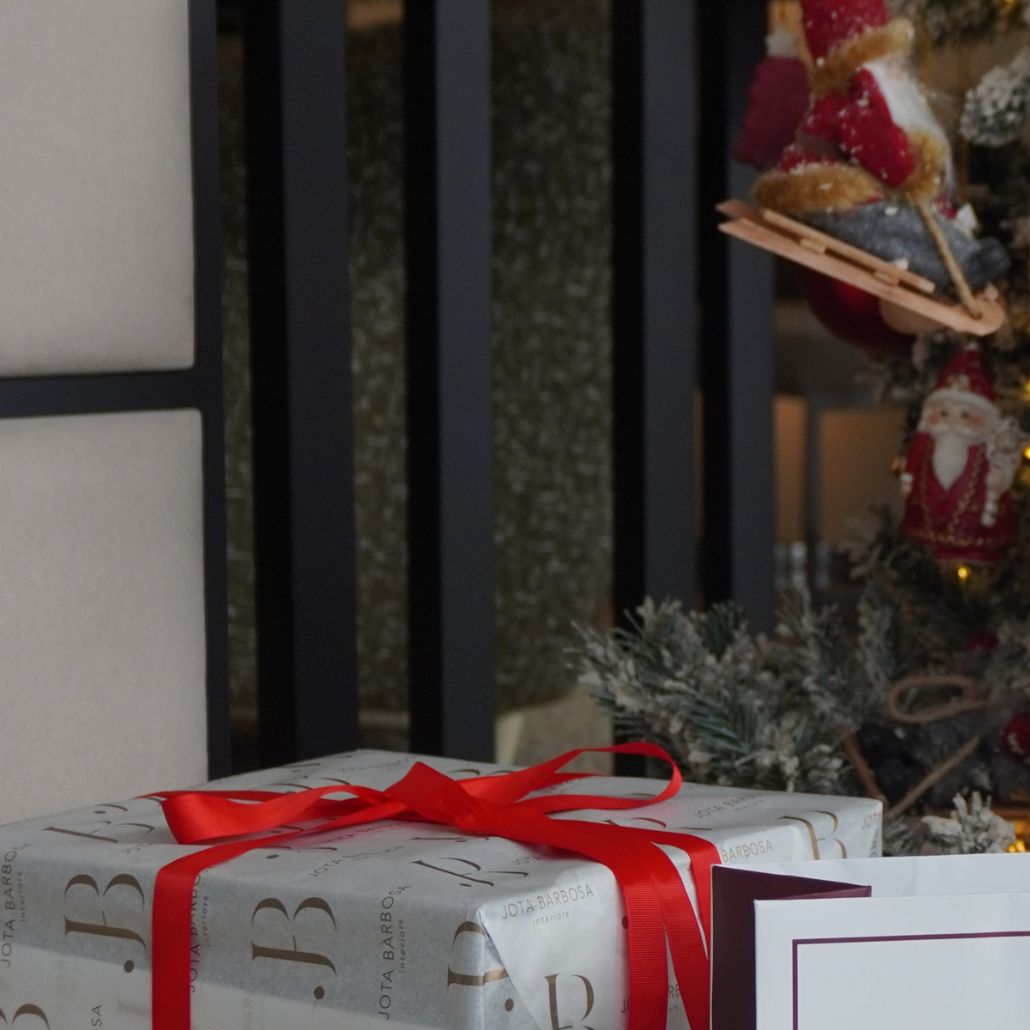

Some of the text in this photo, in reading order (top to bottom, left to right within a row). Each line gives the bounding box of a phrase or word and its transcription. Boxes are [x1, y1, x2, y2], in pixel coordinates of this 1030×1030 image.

[720, 839, 774, 863] BARBOSA
[501, 884, 595, 921] JOTA BARBOSA
[532, 911, 570, 927] interiors
[1, 918, 16, 968] JOTA
[378, 969, 395, 1021] JOTA
